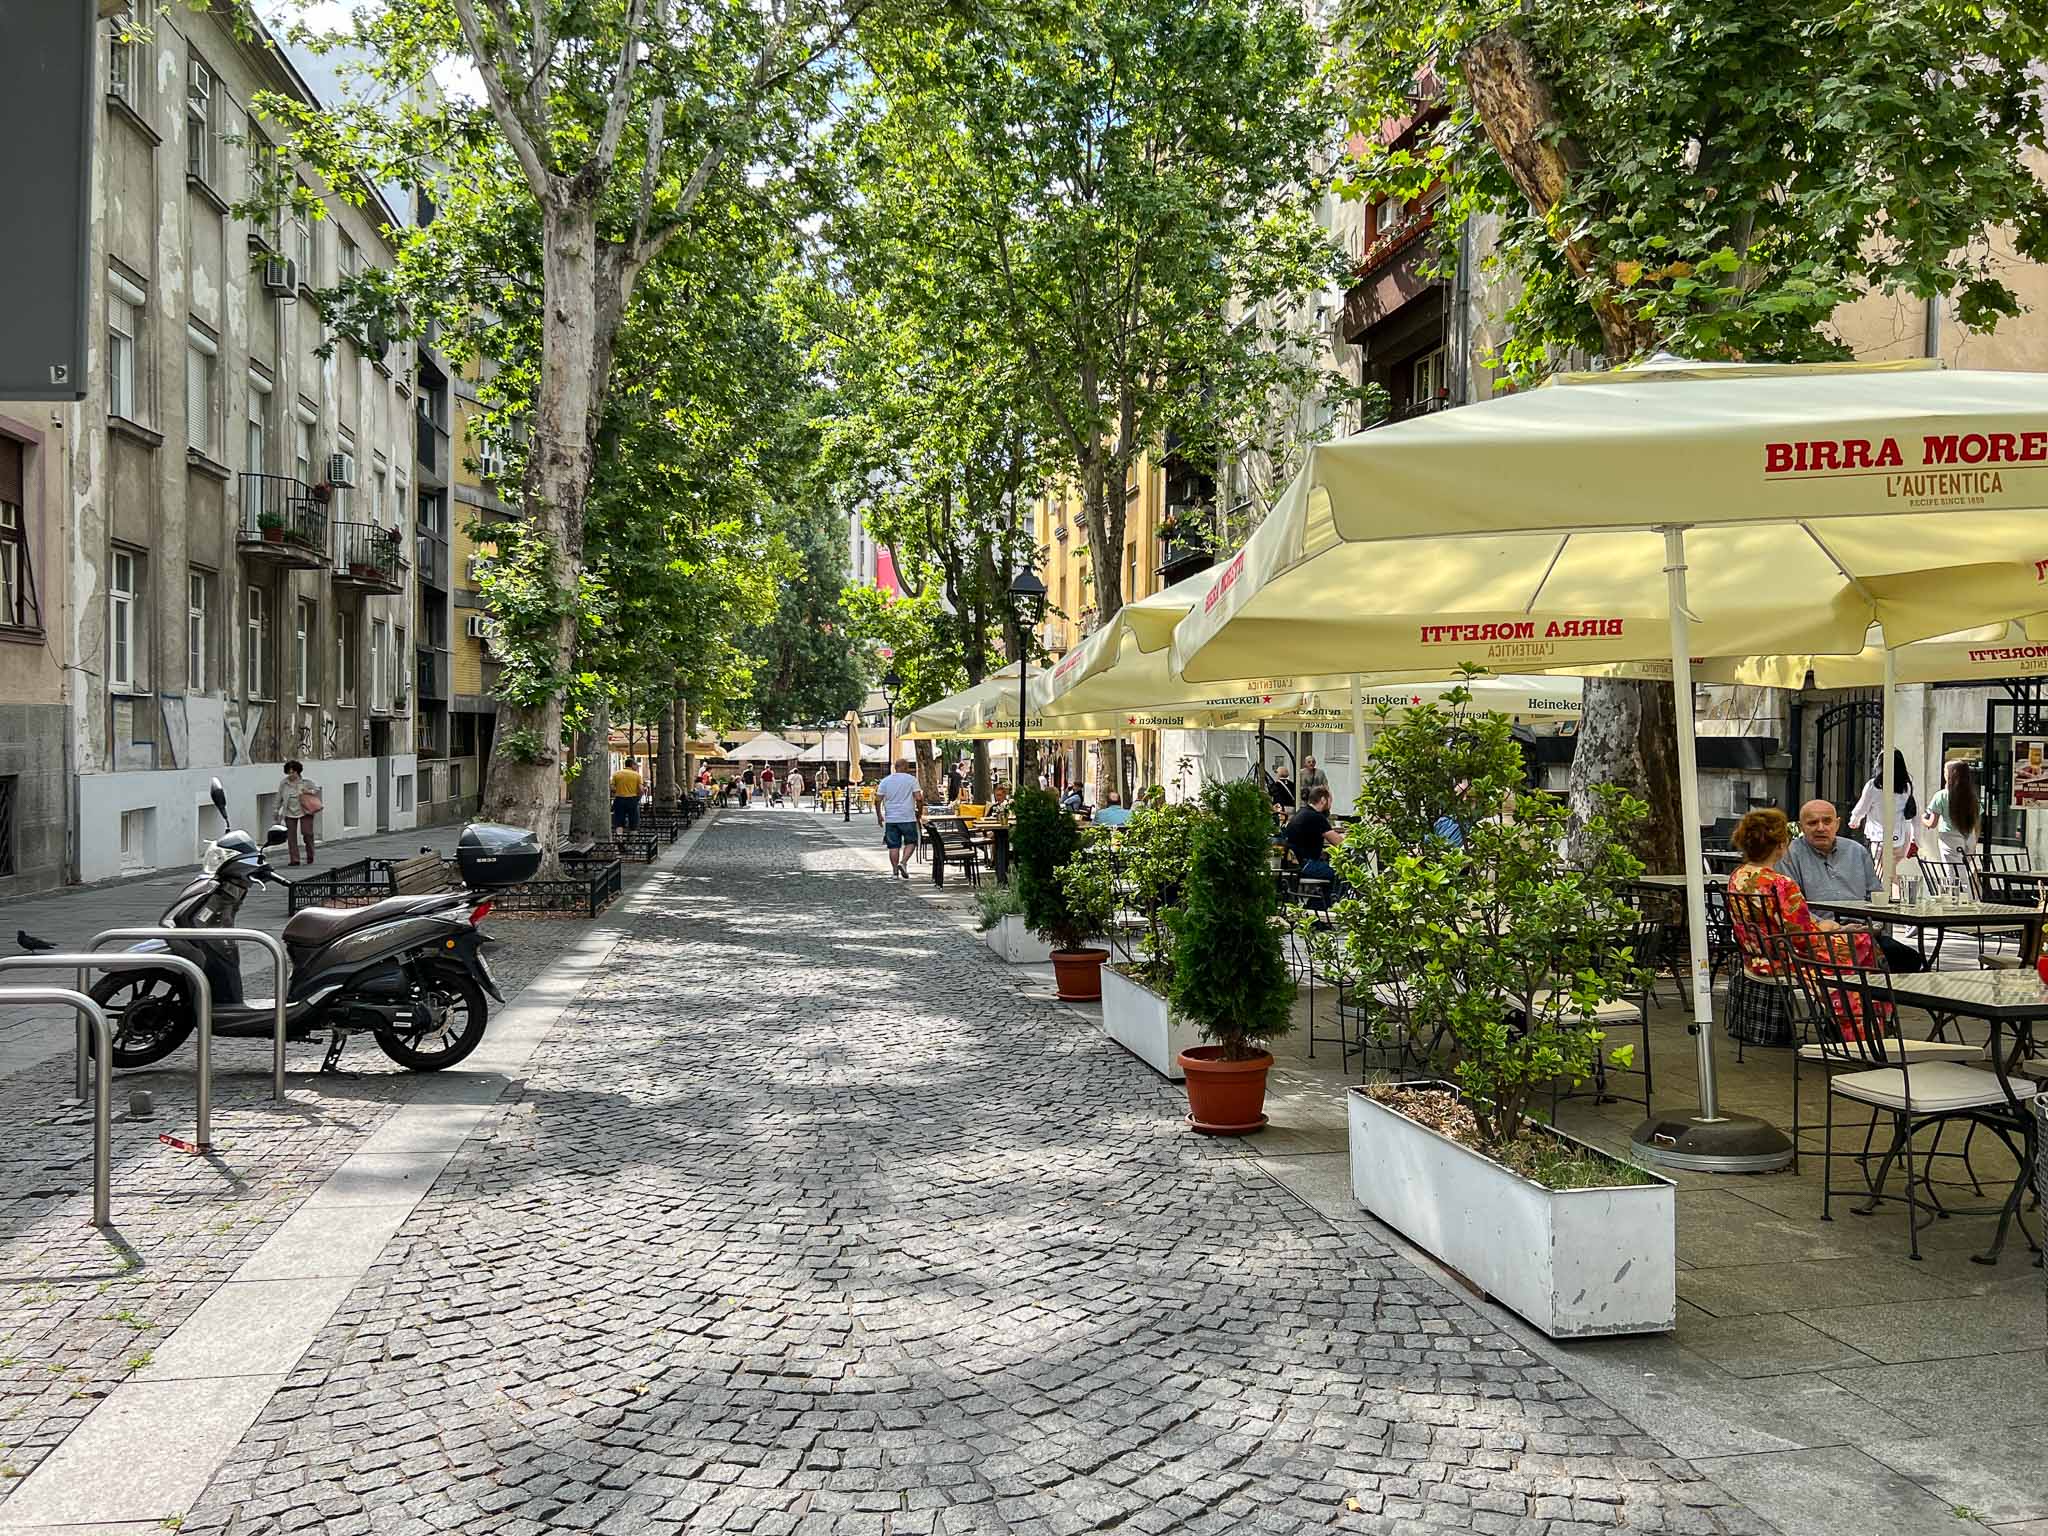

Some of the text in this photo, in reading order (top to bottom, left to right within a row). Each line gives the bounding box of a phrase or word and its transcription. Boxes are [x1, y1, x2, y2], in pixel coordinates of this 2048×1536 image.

[1764, 431, 2048, 473] BIRRA MORE
[1887, 471, 2003, 498] L'AUTENTICA
[1350, 694, 1408, 705] eineken
